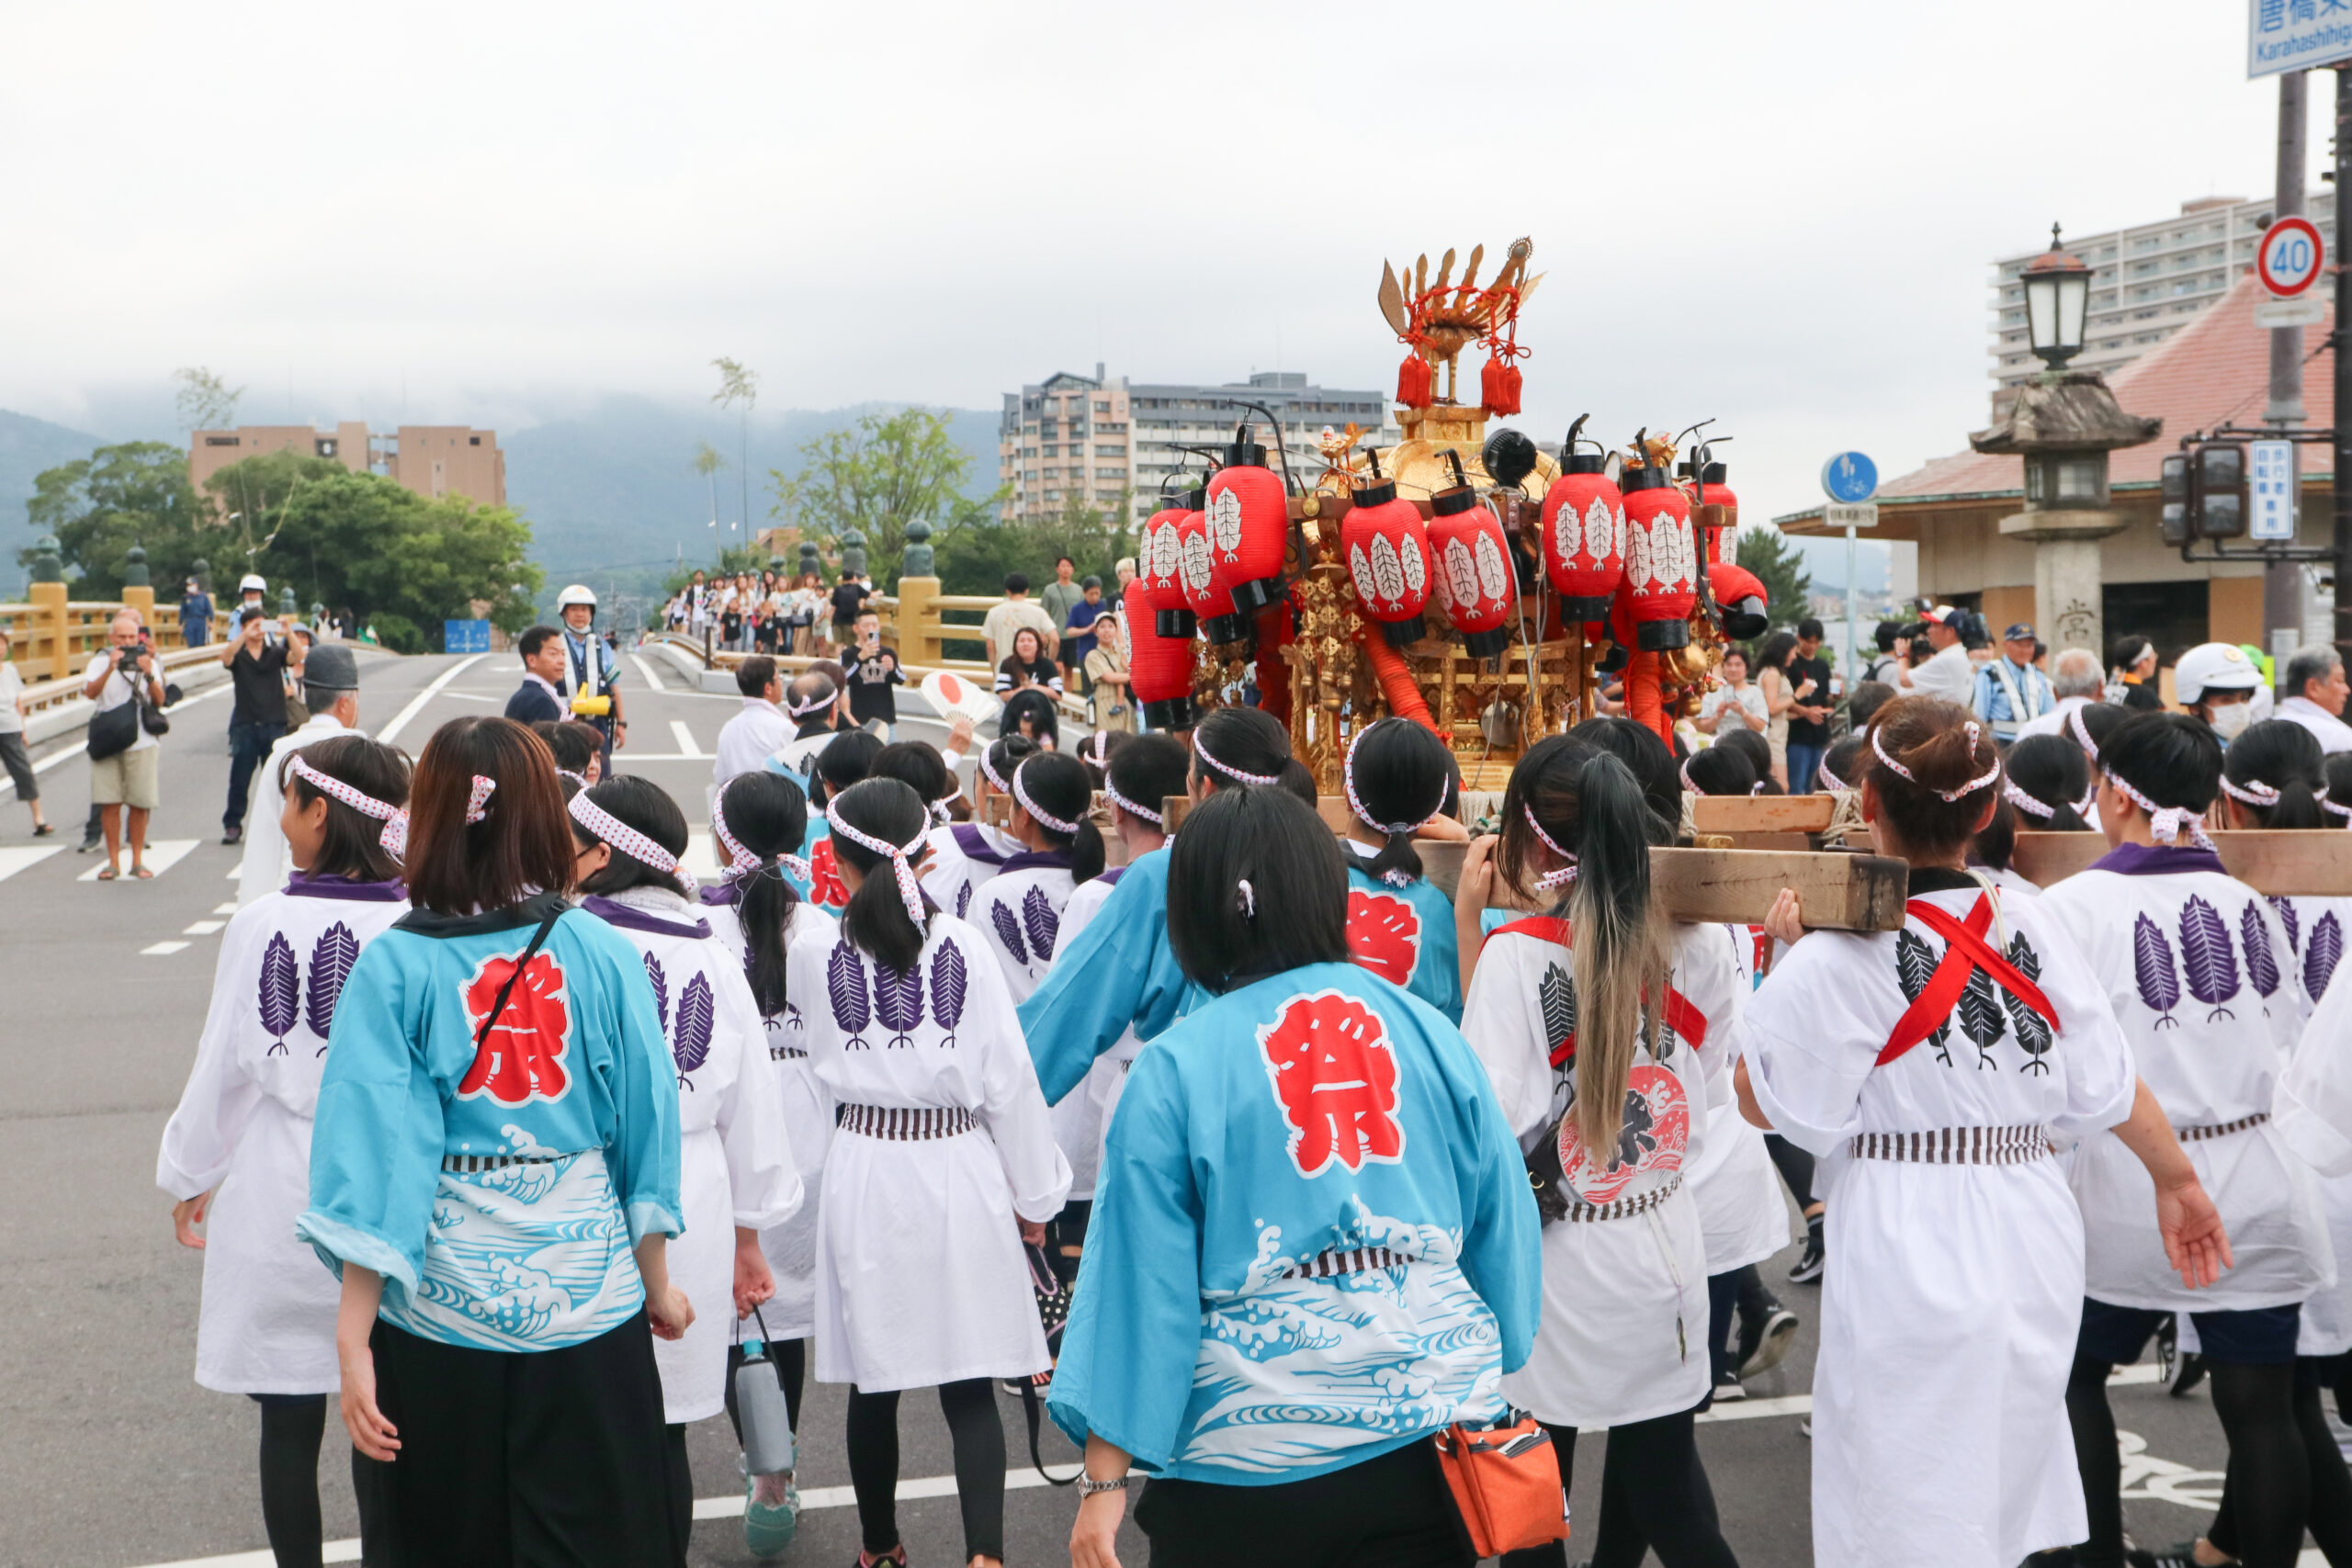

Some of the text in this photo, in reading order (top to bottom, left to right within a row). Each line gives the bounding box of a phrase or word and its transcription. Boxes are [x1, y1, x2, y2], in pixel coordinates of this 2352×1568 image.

[2272, 240, 2309, 274] 40
[456, 949, 571, 1106] 祭
[1256, 988, 1406, 1179] 祭
